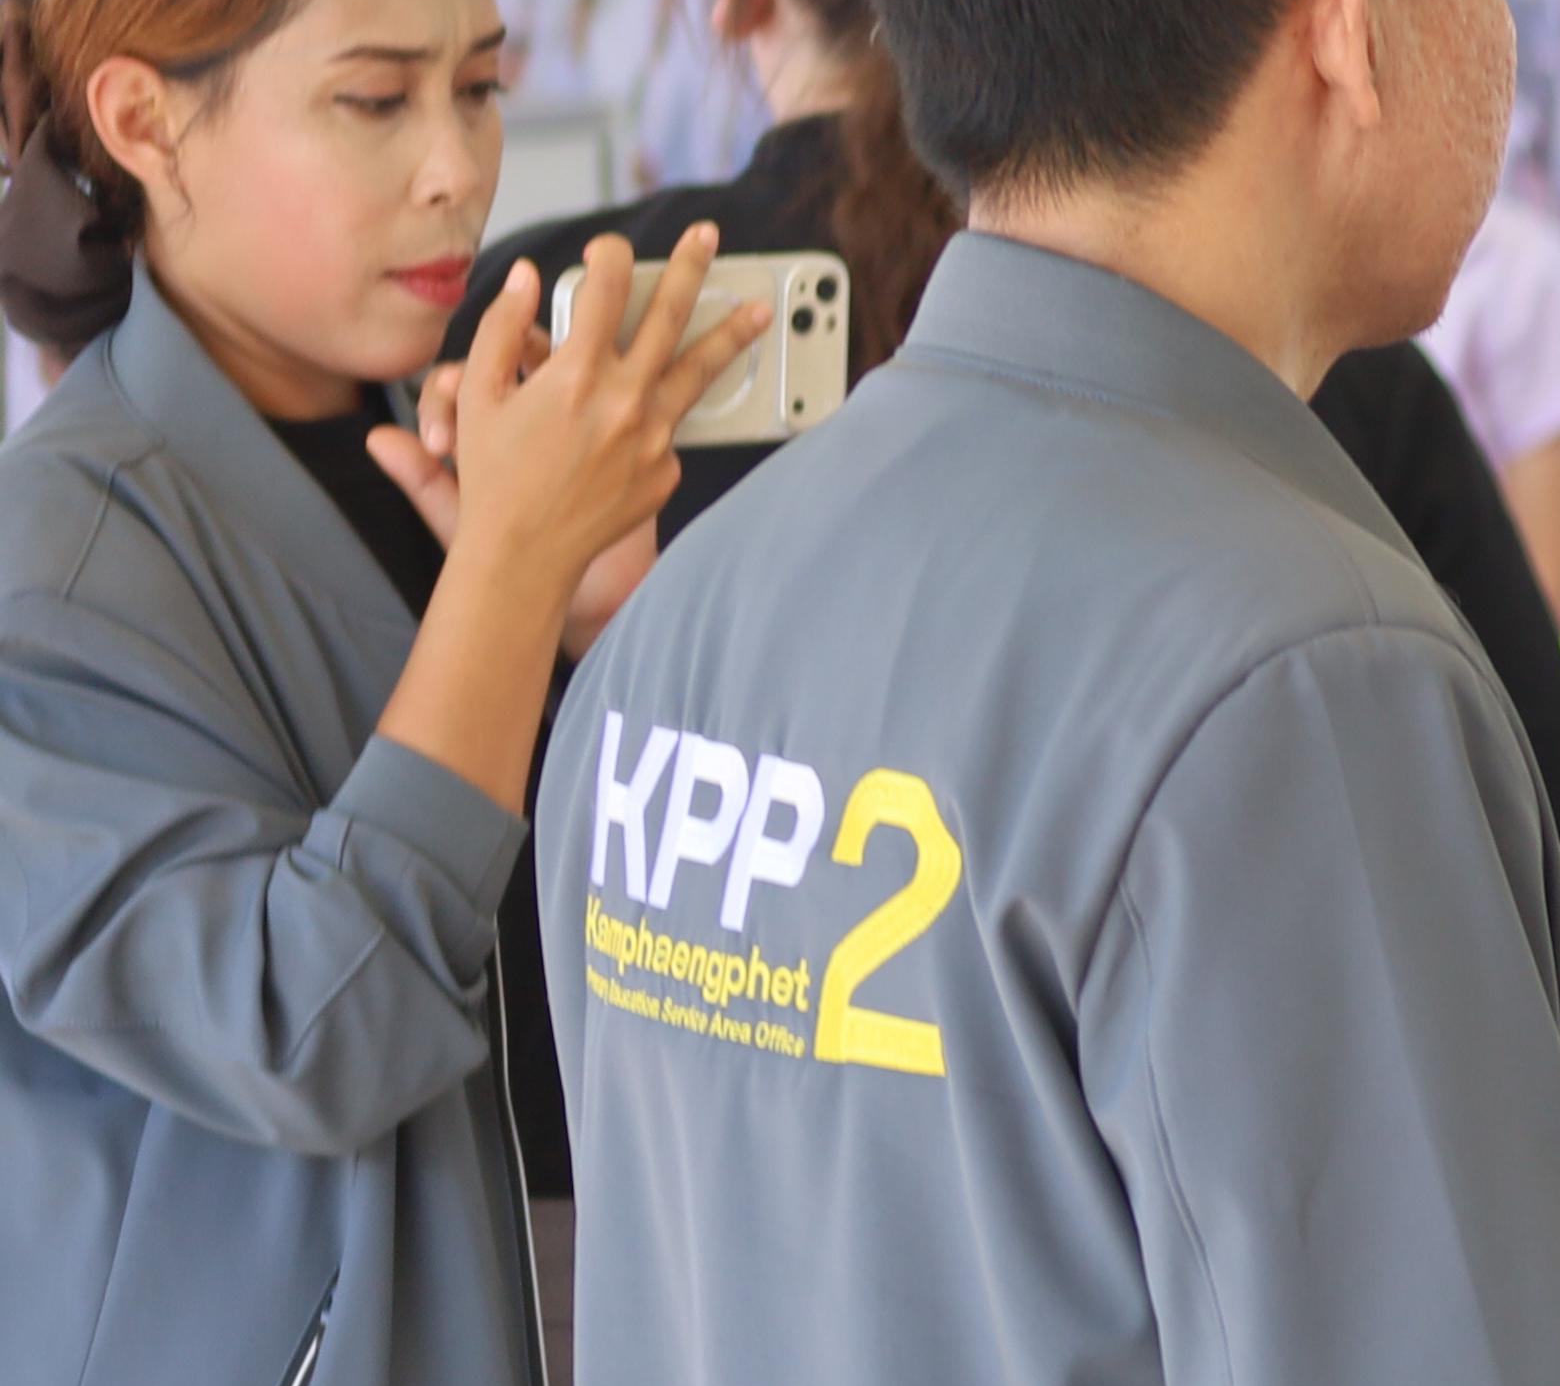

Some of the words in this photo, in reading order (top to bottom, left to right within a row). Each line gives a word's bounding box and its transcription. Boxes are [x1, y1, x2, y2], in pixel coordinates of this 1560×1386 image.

[590, 709, 825, 933] KPP
[586, 895, 810, 1011] Kamphaengphet
[709, 1010, 752, 1046] Area
[754, 1021, 806, 1059] Office
